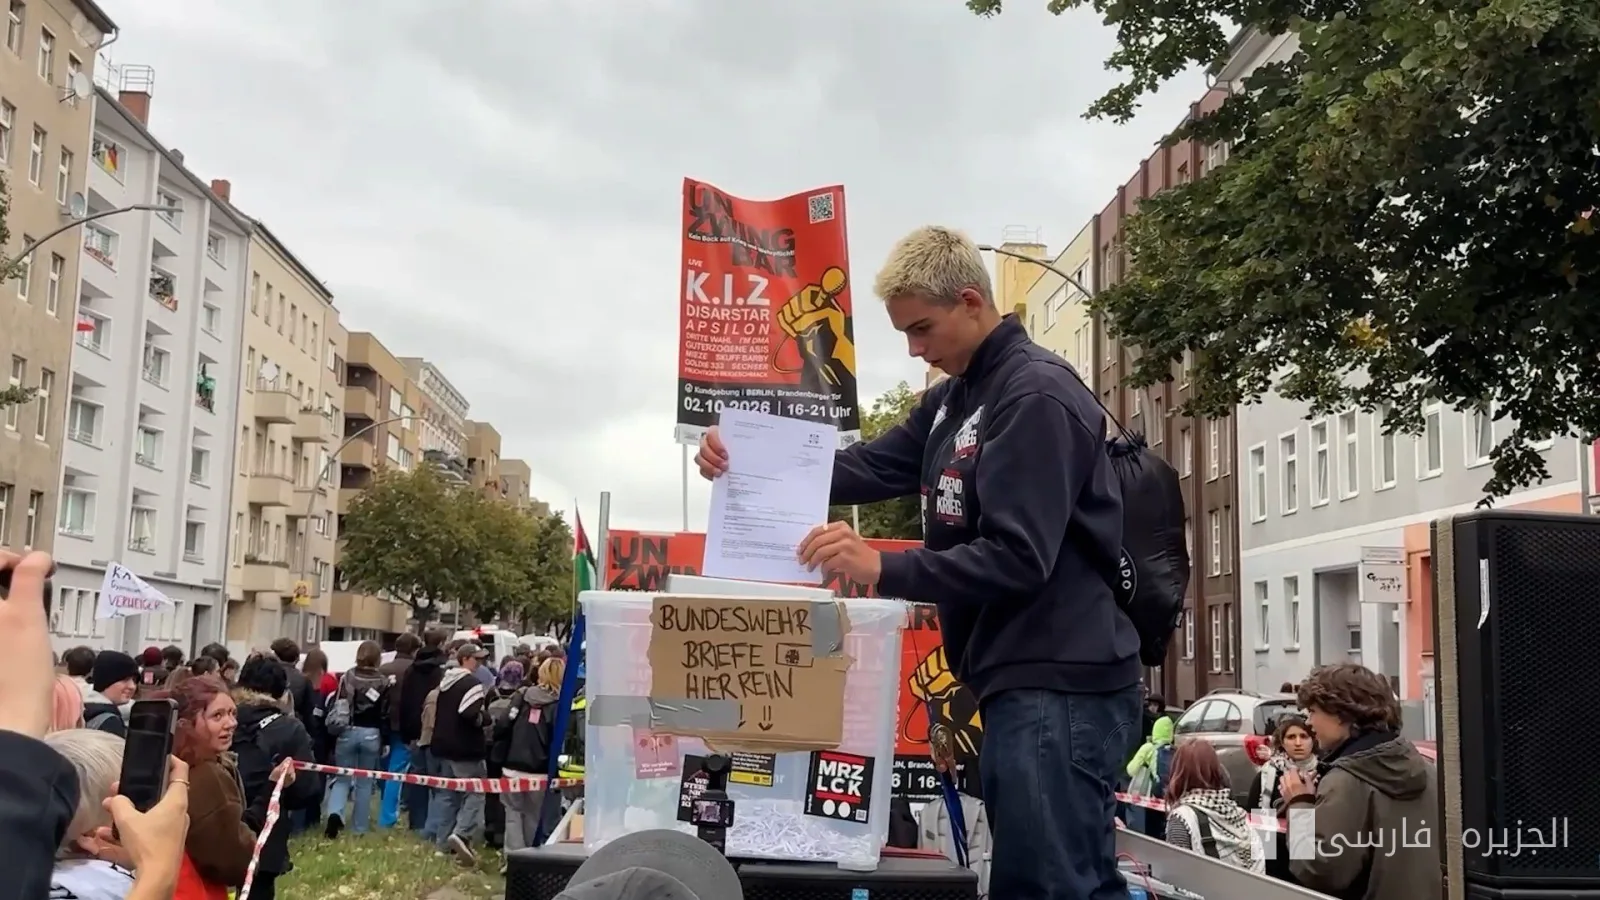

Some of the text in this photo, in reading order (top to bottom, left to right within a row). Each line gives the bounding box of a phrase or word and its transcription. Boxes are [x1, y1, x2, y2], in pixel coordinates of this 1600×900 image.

[690, 185, 734, 217] UN
[702, 235, 719, 243] Bock
[688, 259, 703, 267] LIVE
[686, 269, 770, 306] K.I.Z
[686, 303, 770, 321] DISARSTAR
[685, 341, 769, 353] GUTERZOGENE ASIS
[686, 332, 709, 342] DRITTE
[710, 336, 732, 344] WAHL
[684, 359, 709, 369] GOLDIE
[685, 350, 708, 360] MIEZE
[742, 354, 769, 362] BARBY
[694, 386, 740, 397] Kundgebung
[746, 389, 775, 398] BERLIN,
[777, 390, 830, 401] Brandenburger
[683, 396, 771, 415] 02.102026
[787, 403, 826, 418] 16-21
[829, 406, 852, 419] Uhr
[936, 495, 963, 517] KRIEG
[612, 536, 668, 566] UN
[1119, 556, 1132, 590] NDO
[659, 604, 812, 636] BUNDESWEHR
[681, 640, 765, 671] BRIEFE
[686, 668, 793, 700] HIER REIN
[818, 759, 865, 781] MRZ
[816, 775, 862, 797] LCK
